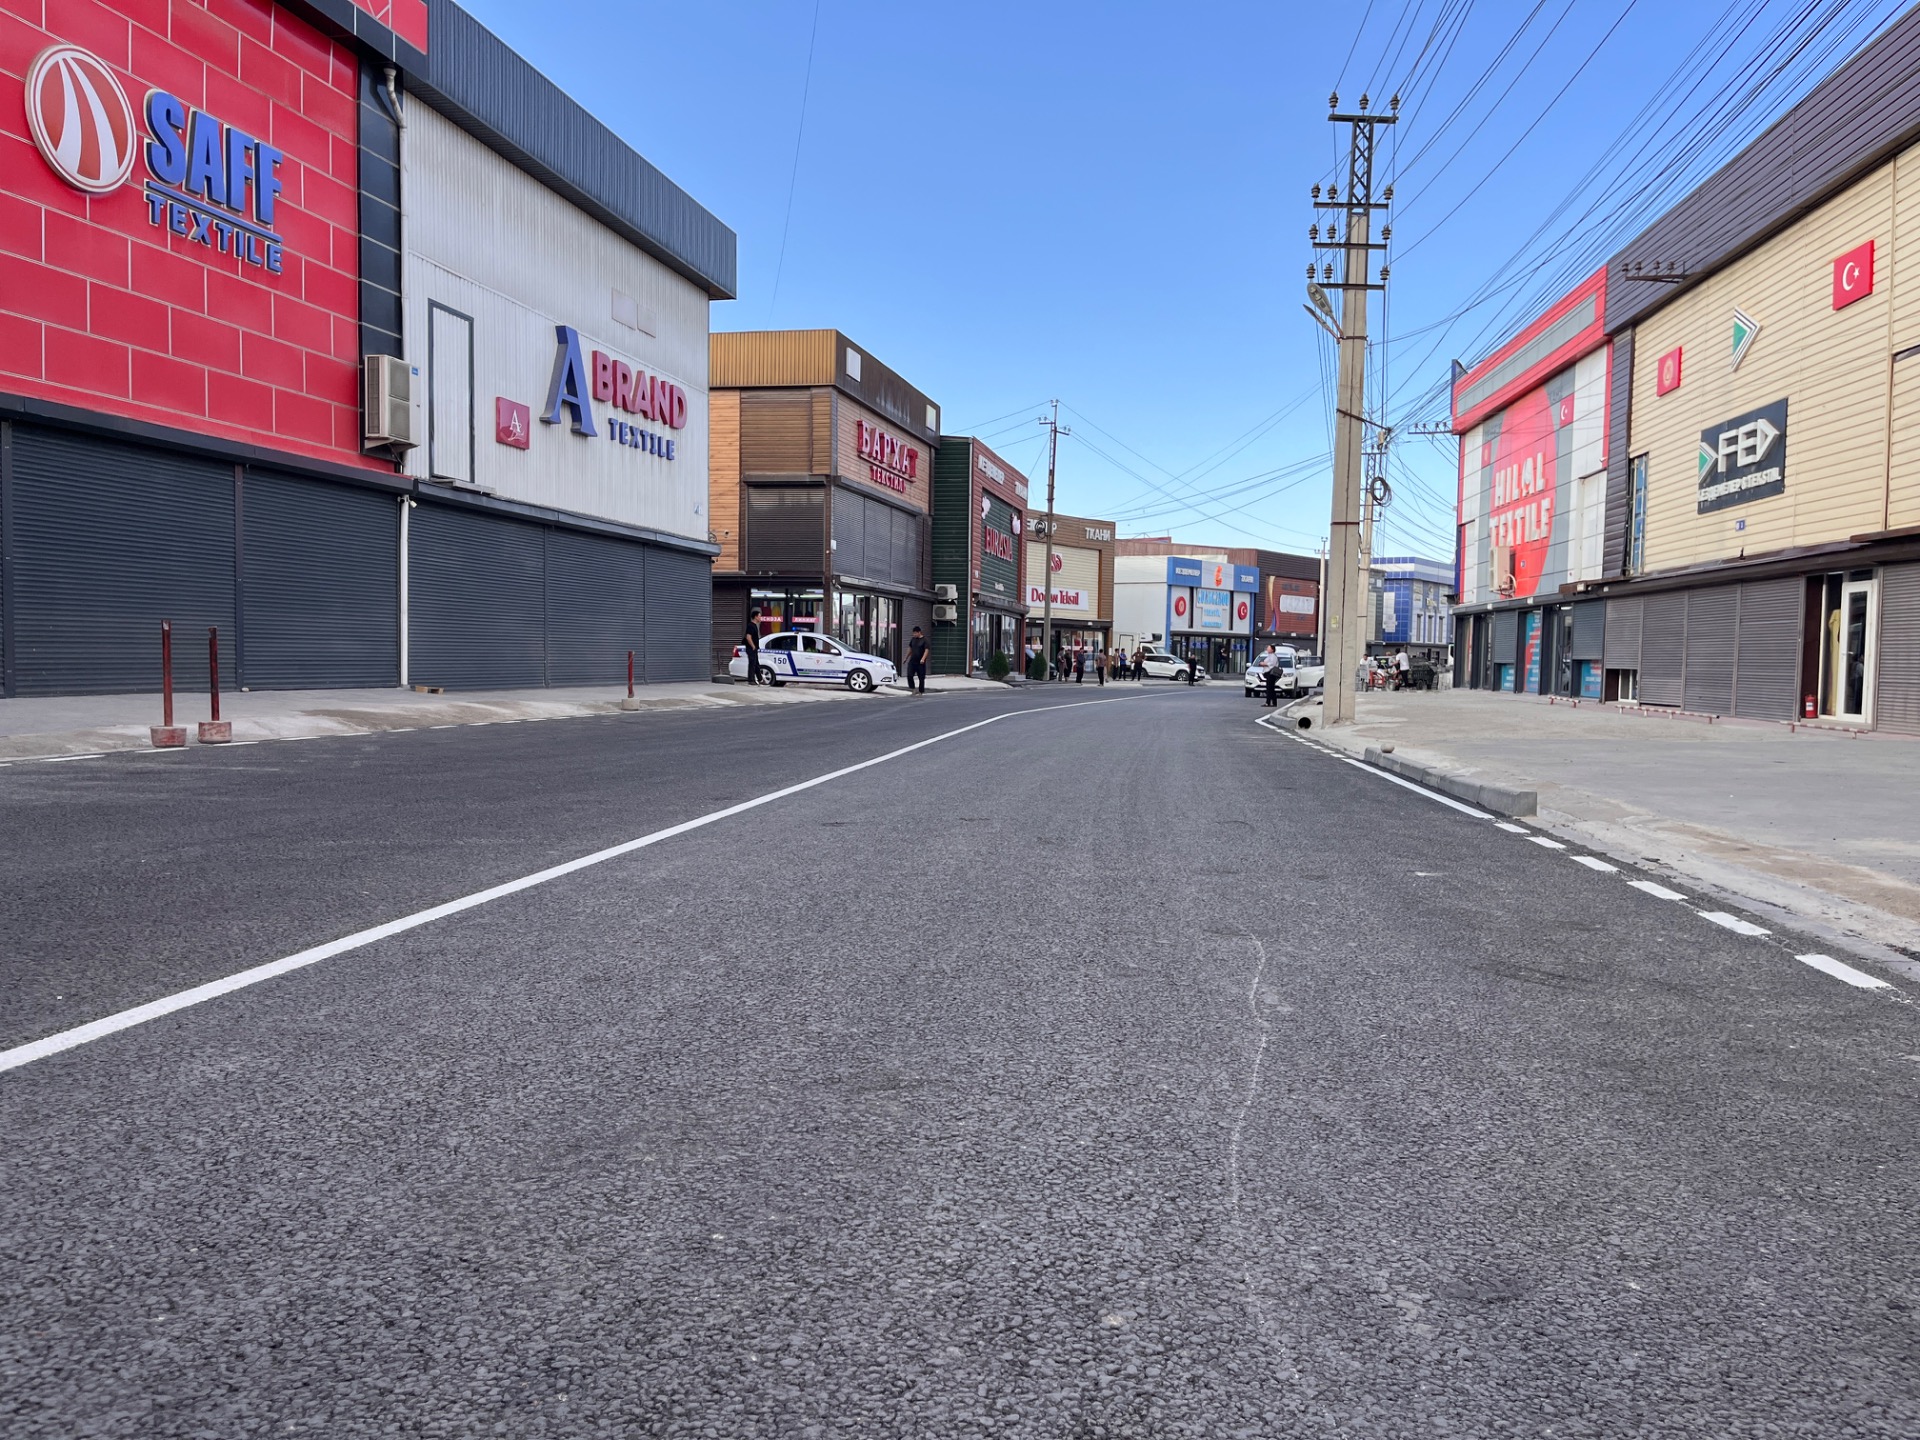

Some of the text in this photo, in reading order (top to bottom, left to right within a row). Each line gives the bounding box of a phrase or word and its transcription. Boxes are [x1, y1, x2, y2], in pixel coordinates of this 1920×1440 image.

[144, 88, 283, 227] SAFF
[144, 190, 283, 275] TEXTILE
[592, 350, 688, 429] BRAND
[608, 417, 675, 460] TEXTILE
[857, 420, 918, 478] БАРХАТ
[1495, 452, 1546, 508] HILAL
[1085, 527, 1111, 541] ТКАНИ
[1490, 498, 1550, 548] TEXTILE
[773, 657, 787, 665] 150
